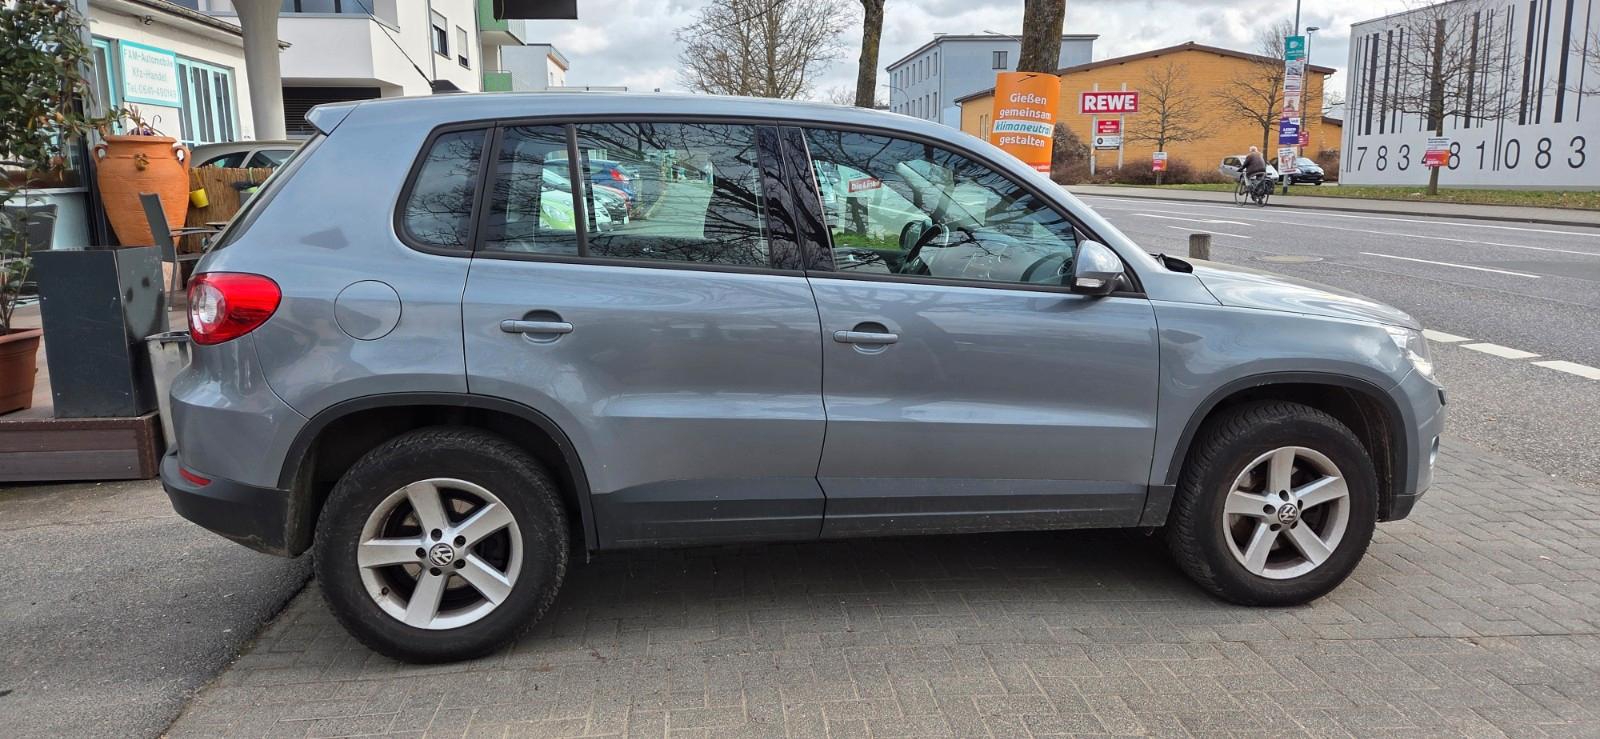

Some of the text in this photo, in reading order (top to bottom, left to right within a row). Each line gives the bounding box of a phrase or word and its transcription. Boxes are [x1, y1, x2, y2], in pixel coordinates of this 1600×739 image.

[1009, 92, 1047, 105] Gießen
[1084, 94, 1135, 111] REWE
[999, 107, 1052, 120] gemeinsam
[999, 135, 1045, 148] gestalten
